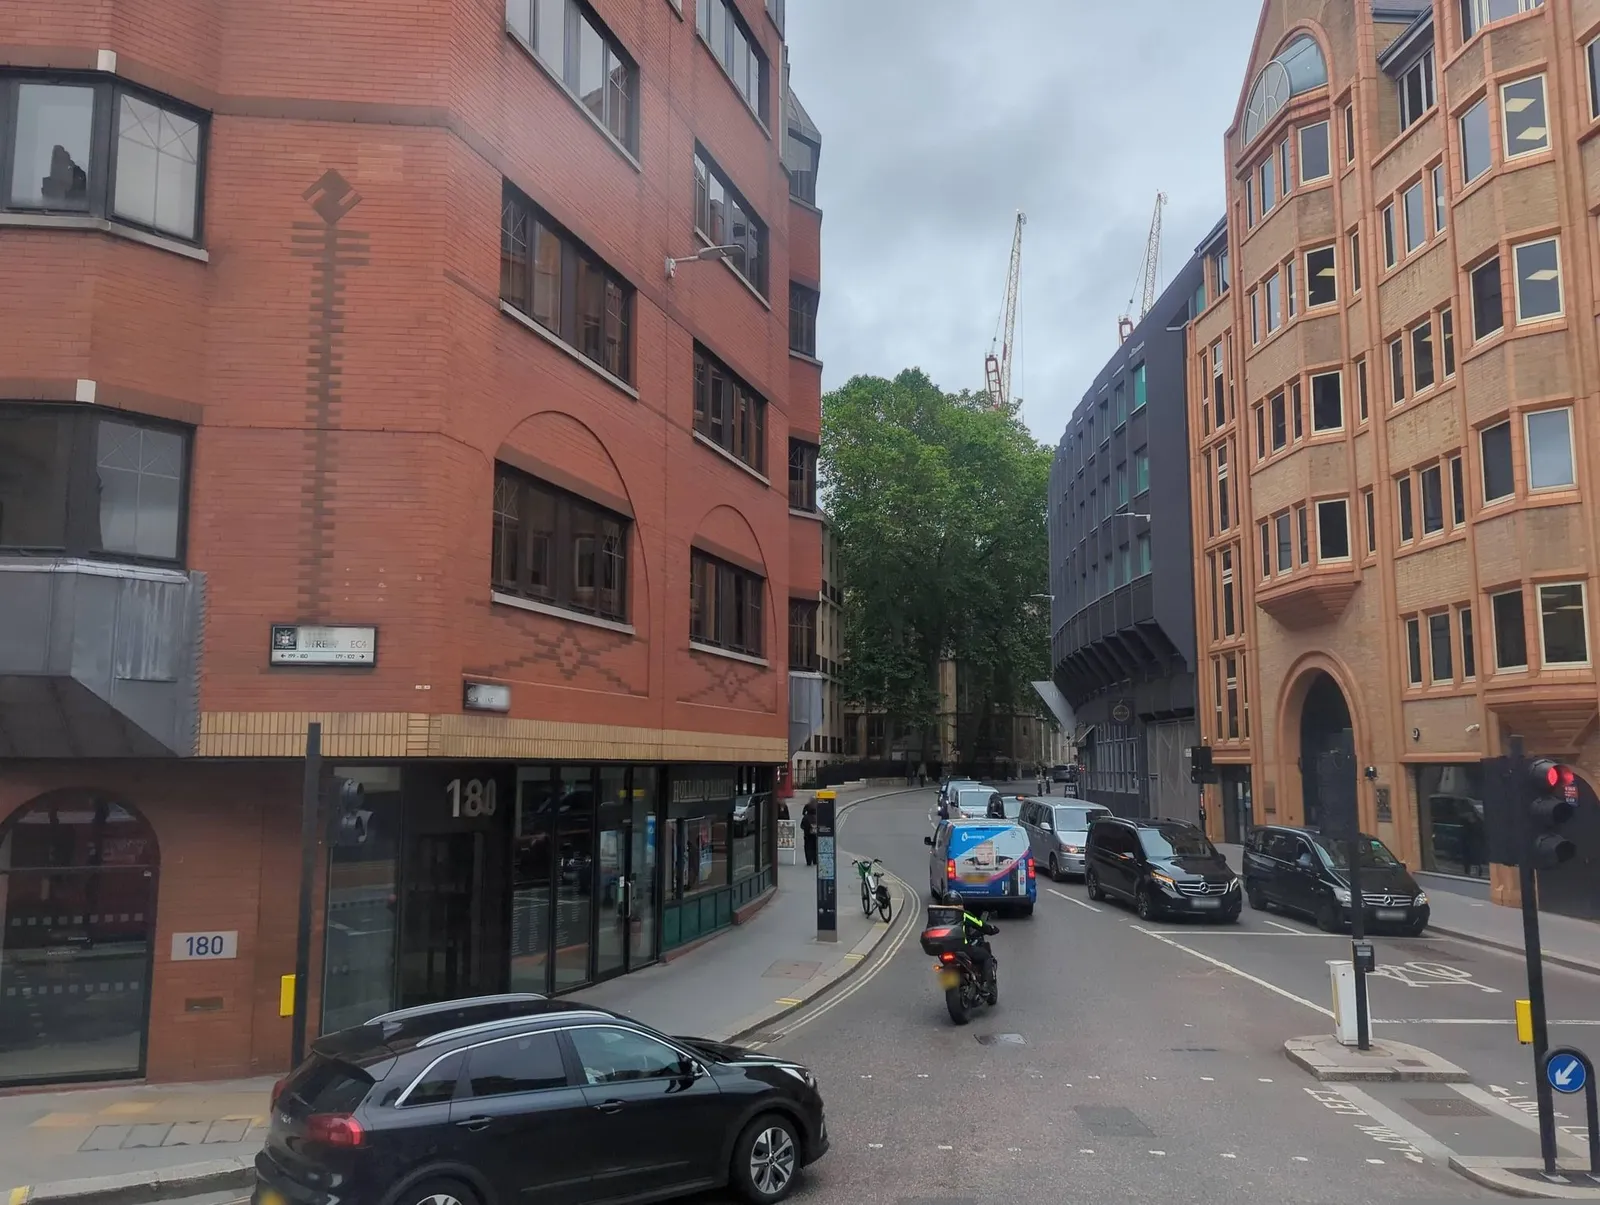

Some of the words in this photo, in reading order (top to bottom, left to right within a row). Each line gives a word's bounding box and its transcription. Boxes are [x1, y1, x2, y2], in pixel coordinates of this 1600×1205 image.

[350, 640, 367, 649] EC4
[446, 778, 496, 817] 180
[185, 935, 224, 956] 180
[1302, 1087, 1368, 1116] LEFT
